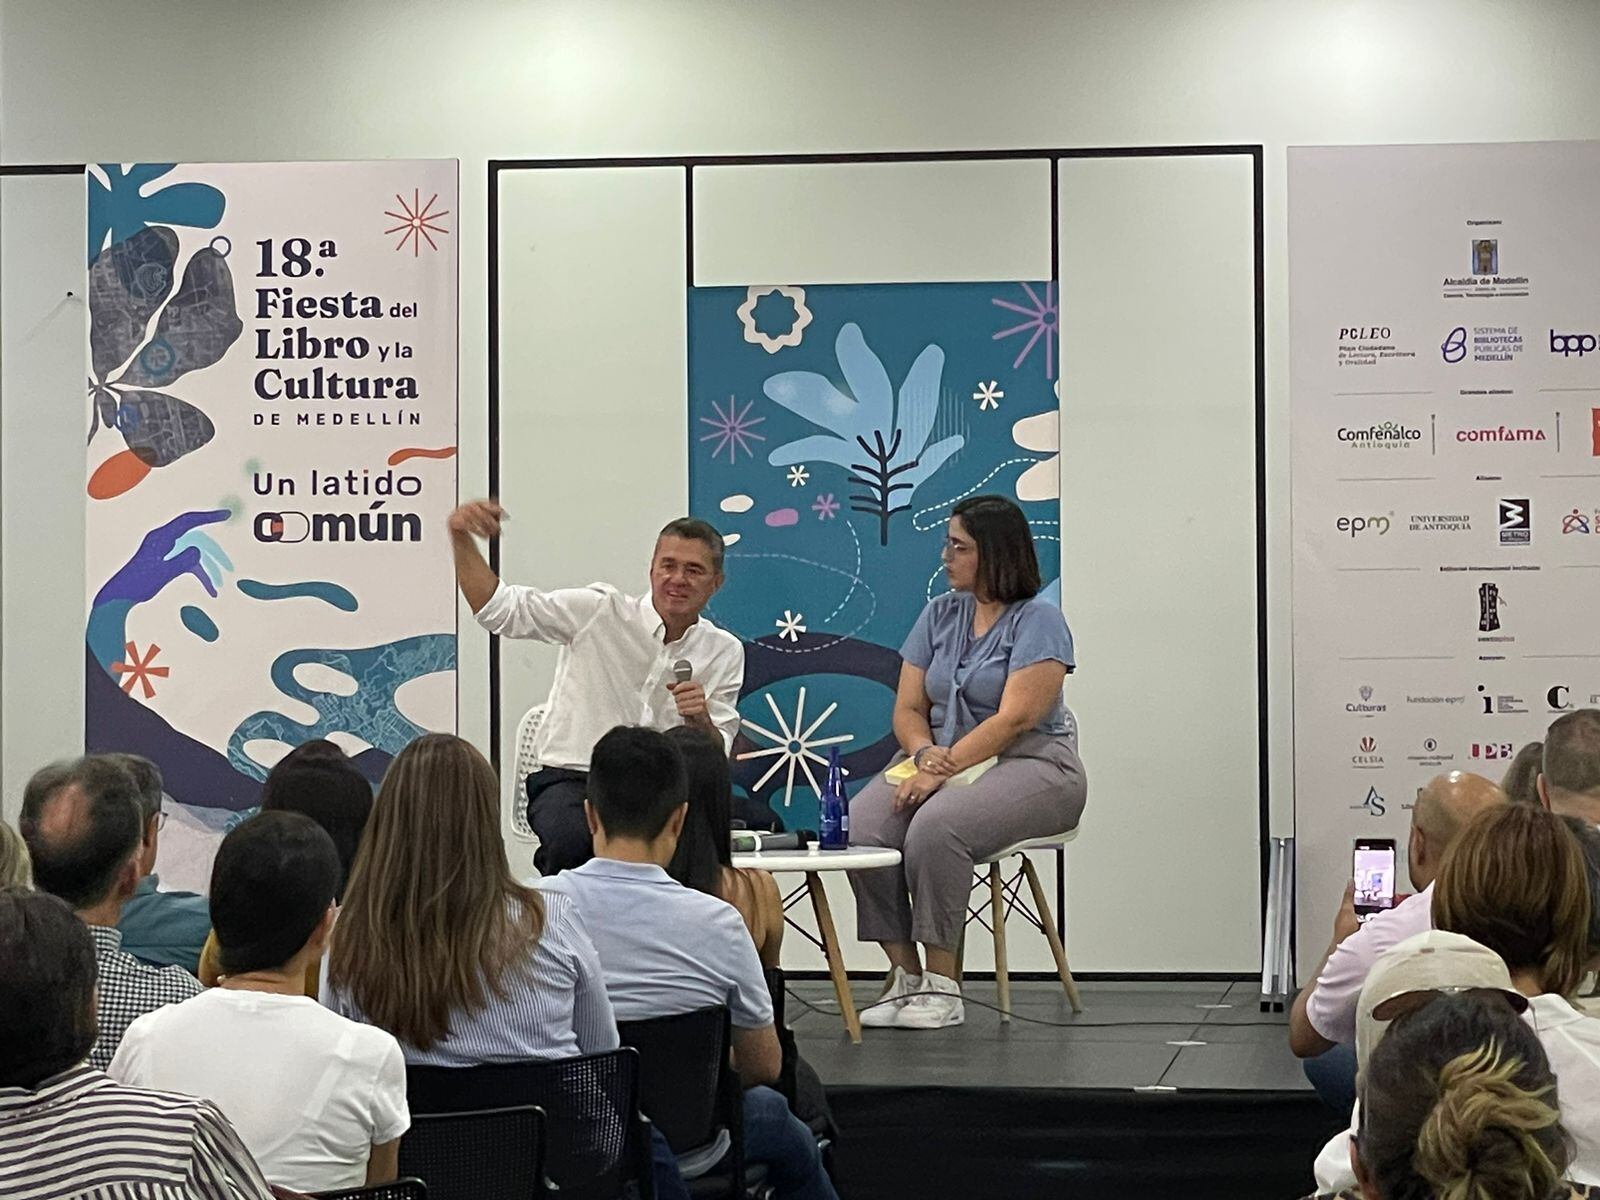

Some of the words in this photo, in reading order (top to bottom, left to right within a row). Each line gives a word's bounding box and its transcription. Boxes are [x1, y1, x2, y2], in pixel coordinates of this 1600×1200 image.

[1479, 277, 1491, 285] de
[255, 286, 384, 319] Fiesta
[389, 302, 418, 318] del
[1339, 327, 1391, 340] PCLEO
[1473, 327, 1507, 335] SISTEMA
[1508, 326, 1518, 334] DE
[255, 326, 370, 360] Libro
[378, 345, 390, 363] y
[395, 342, 413, 358] la
[1473, 335, 1523, 344] BIBLIOTECAS
[1550, 328, 1597, 357] bpp
[1513, 344, 1523, 352] DE
[254, 366, 419, 400] Cultura
[254, 413, 281, 426] DE
[297, 409, 421, 426] MEDELLÍN
[1337, 425, 1421, 441] Comfenalco
[1456, 425, 1546, 442] comfama
[1351, 441, 1410, 449] Antioquia
[253, 472, 295, 496] Un
[311, 468, 422, 496] latido
[253, 500, 422, 543] común
[1410, 515, 1470, 523] UNIVERSIDAD
[1336, 516, 1390, 538] epm
[1423, 523, 1472, 531] ANTIOQUIA
[1345, 703, 1387, 712] Culturas
[1351, 755, 1385, 763] CELSIA
